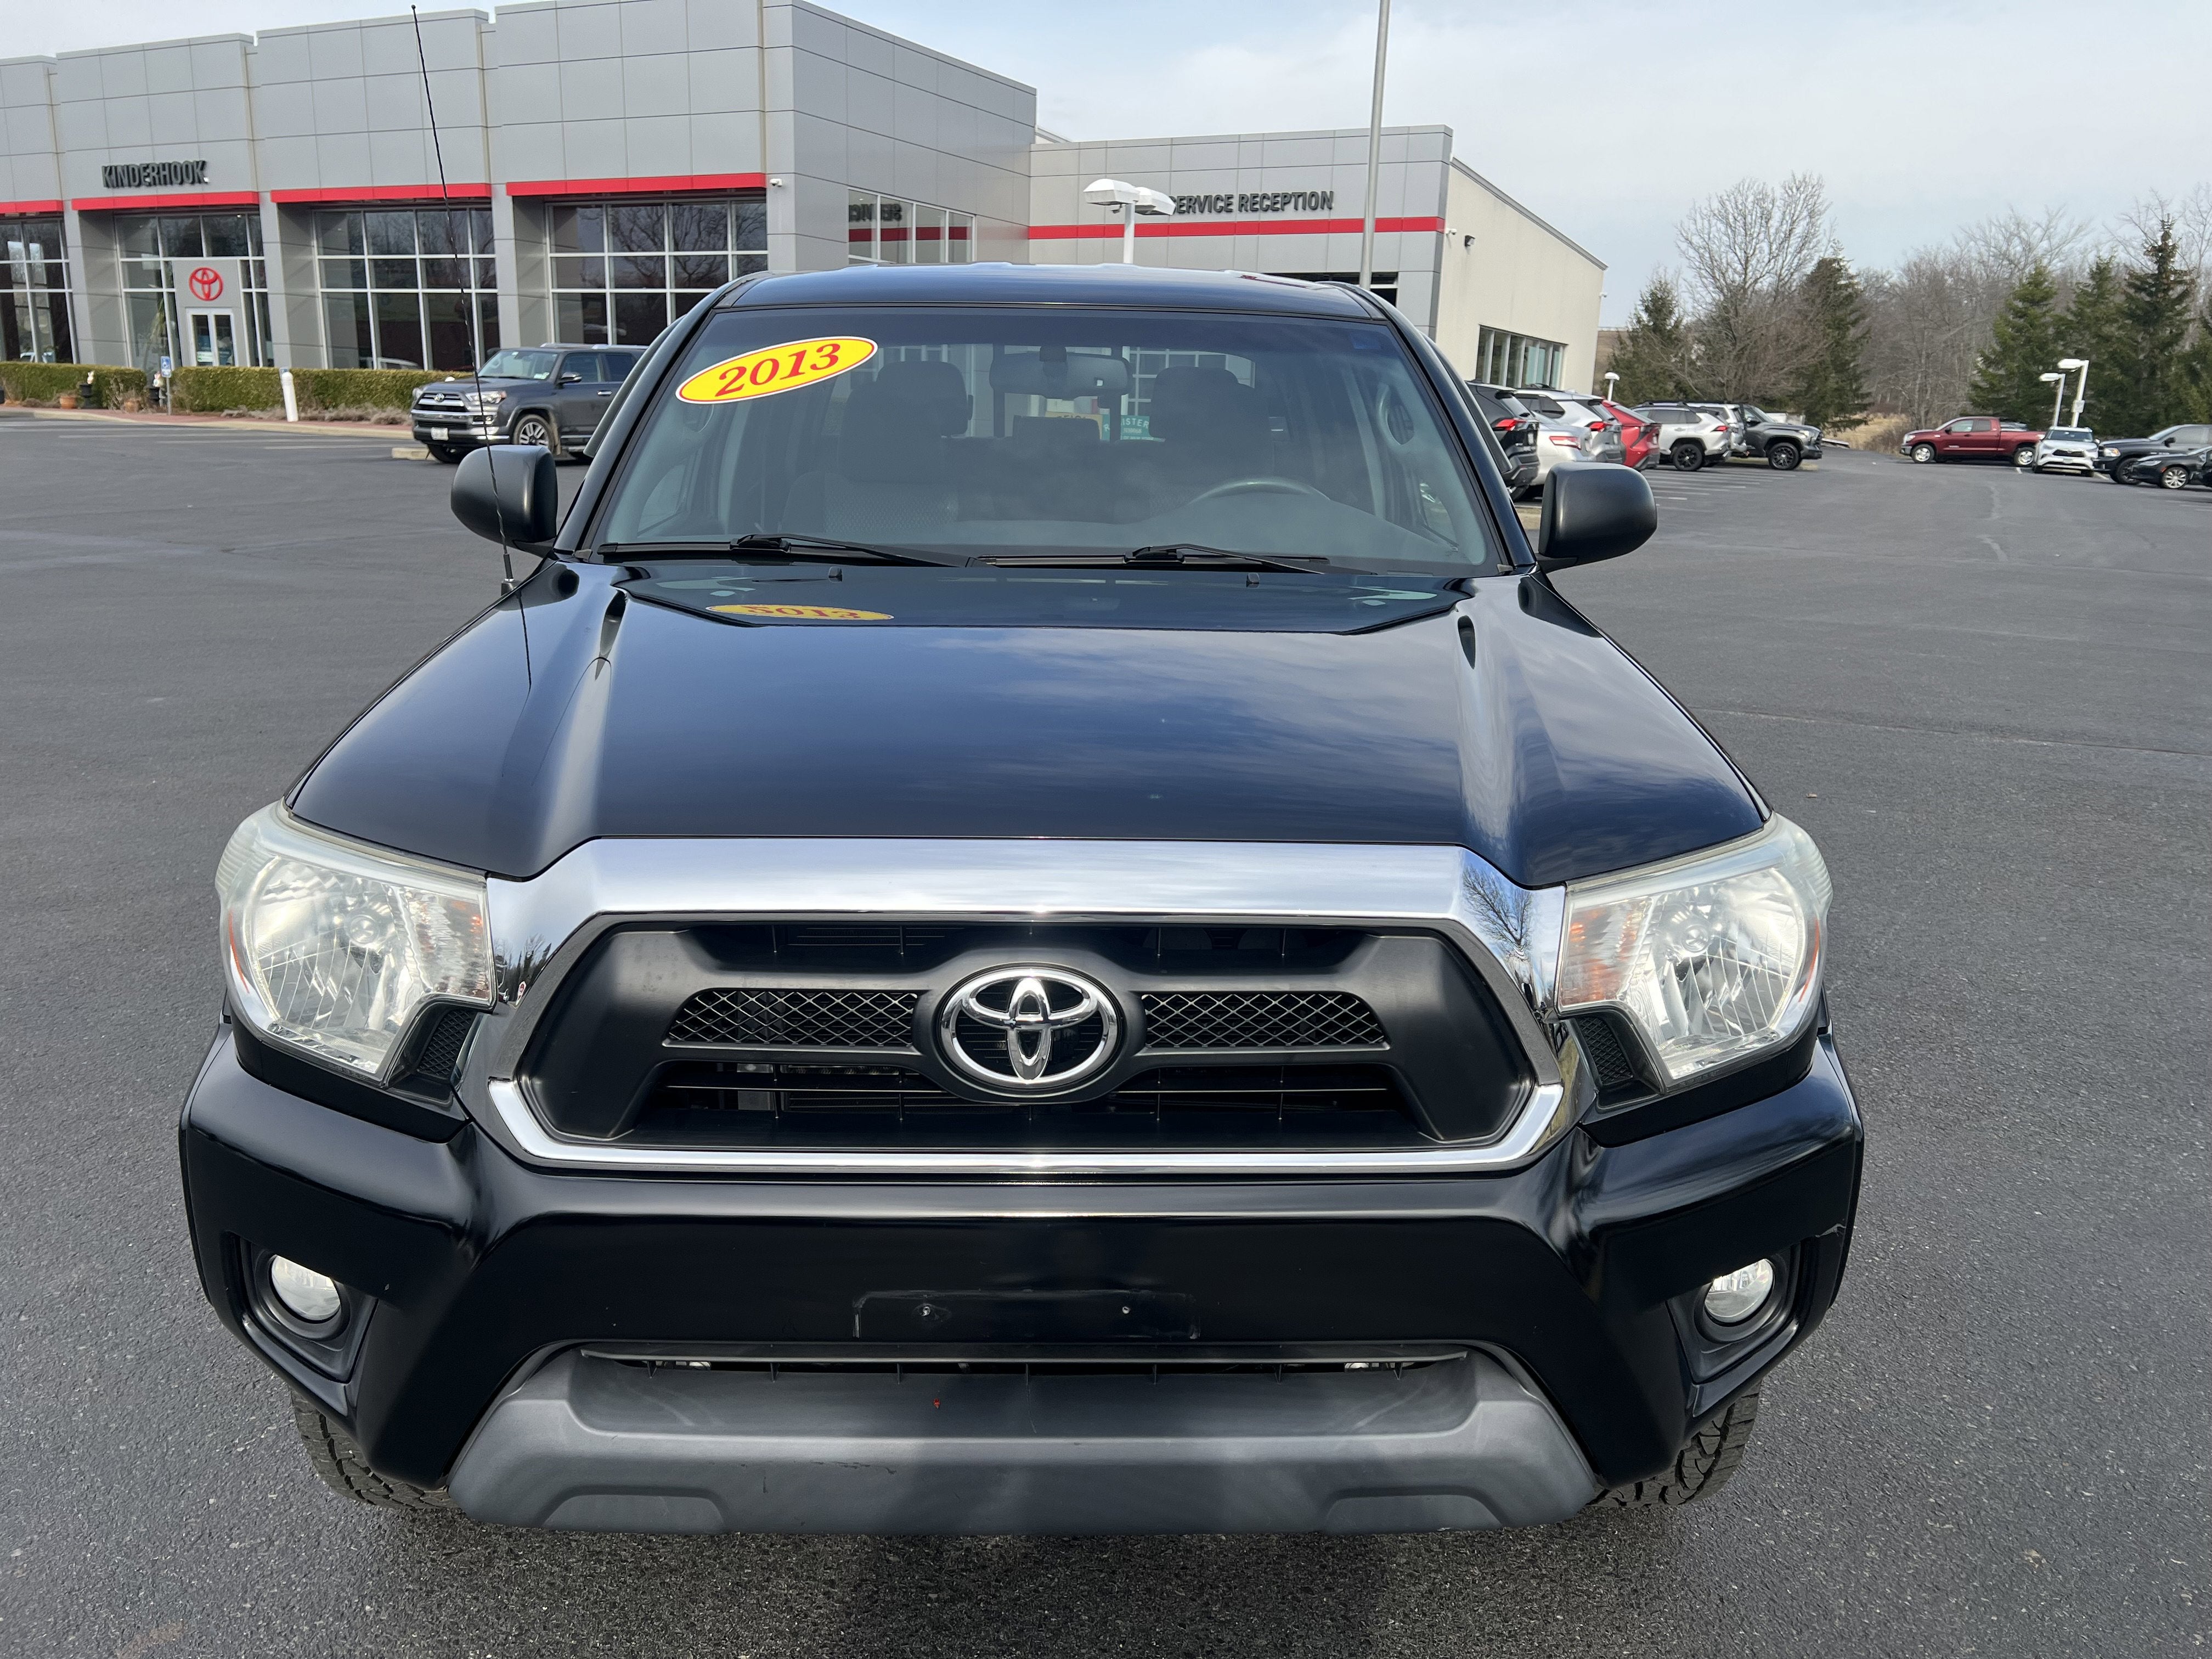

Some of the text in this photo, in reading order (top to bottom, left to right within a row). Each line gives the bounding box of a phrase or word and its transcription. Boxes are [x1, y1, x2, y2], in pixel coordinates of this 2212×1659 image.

[102, 160, 208, 188] KINDERHOOK
[1238, 191, 1334, 212] RECEPTION
[714, 343, 840, 397] 2013
